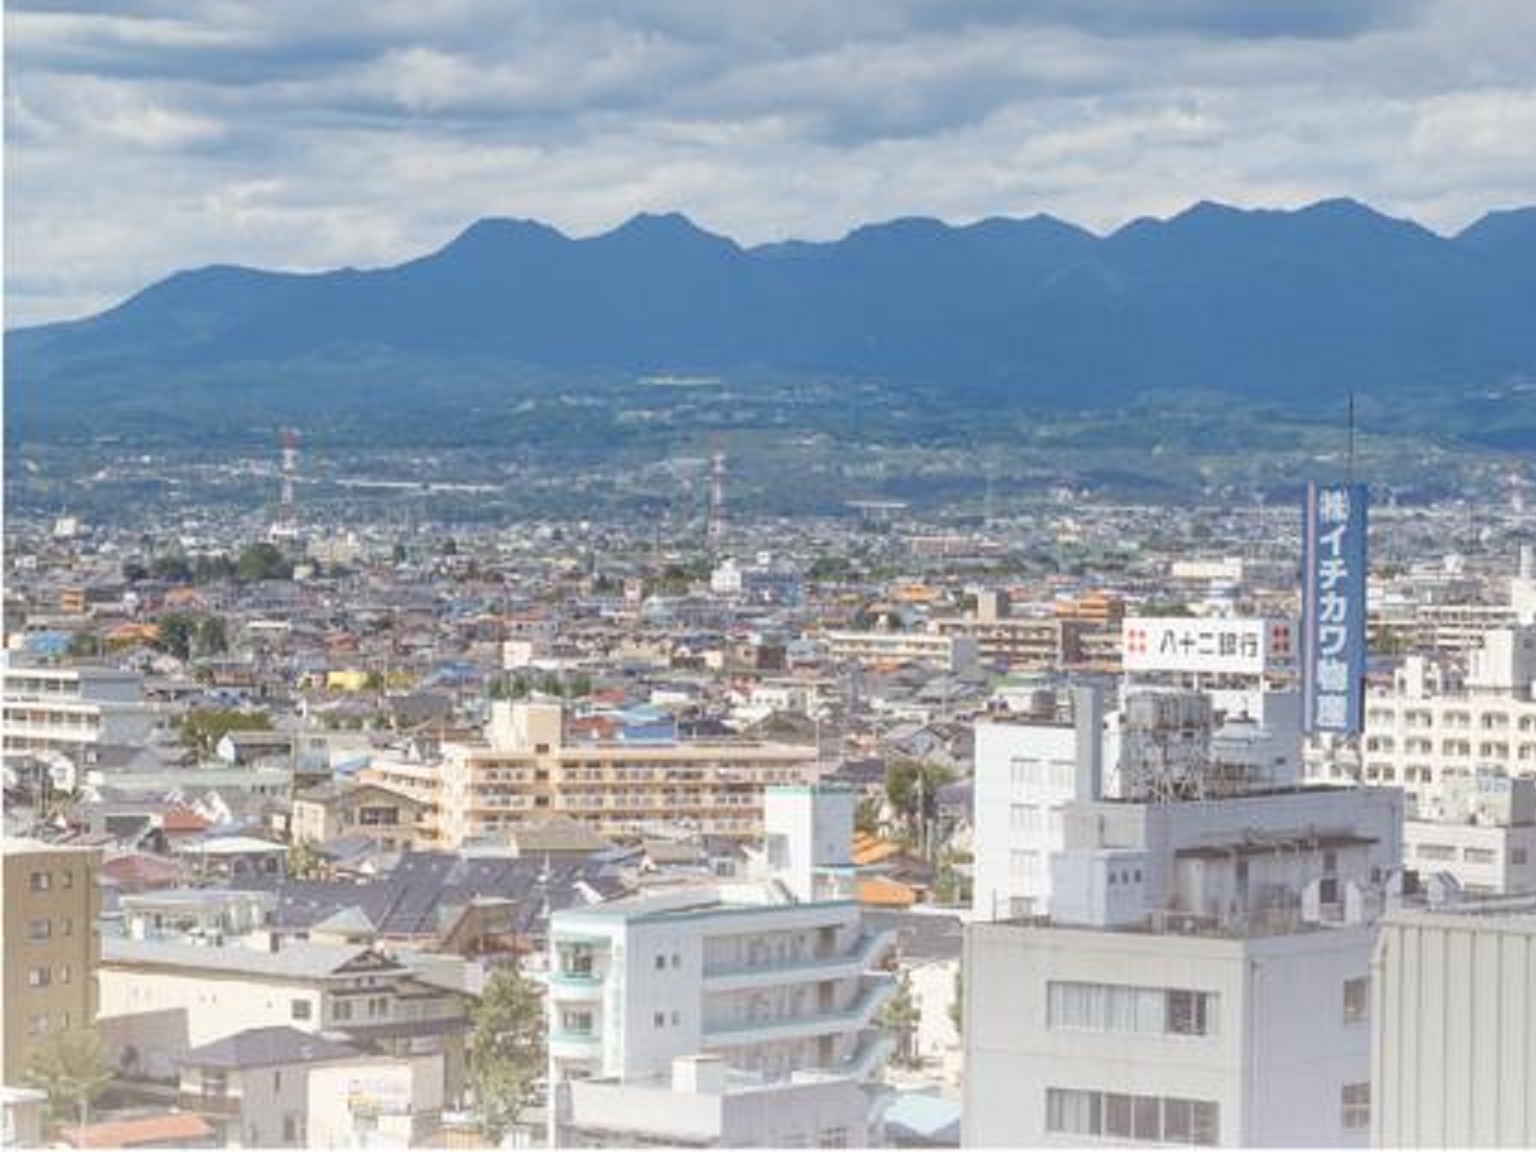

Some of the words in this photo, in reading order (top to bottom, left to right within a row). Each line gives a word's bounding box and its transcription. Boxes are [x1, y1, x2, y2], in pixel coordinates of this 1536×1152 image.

[1159, 629, 1258, 658] 八十二銀行
